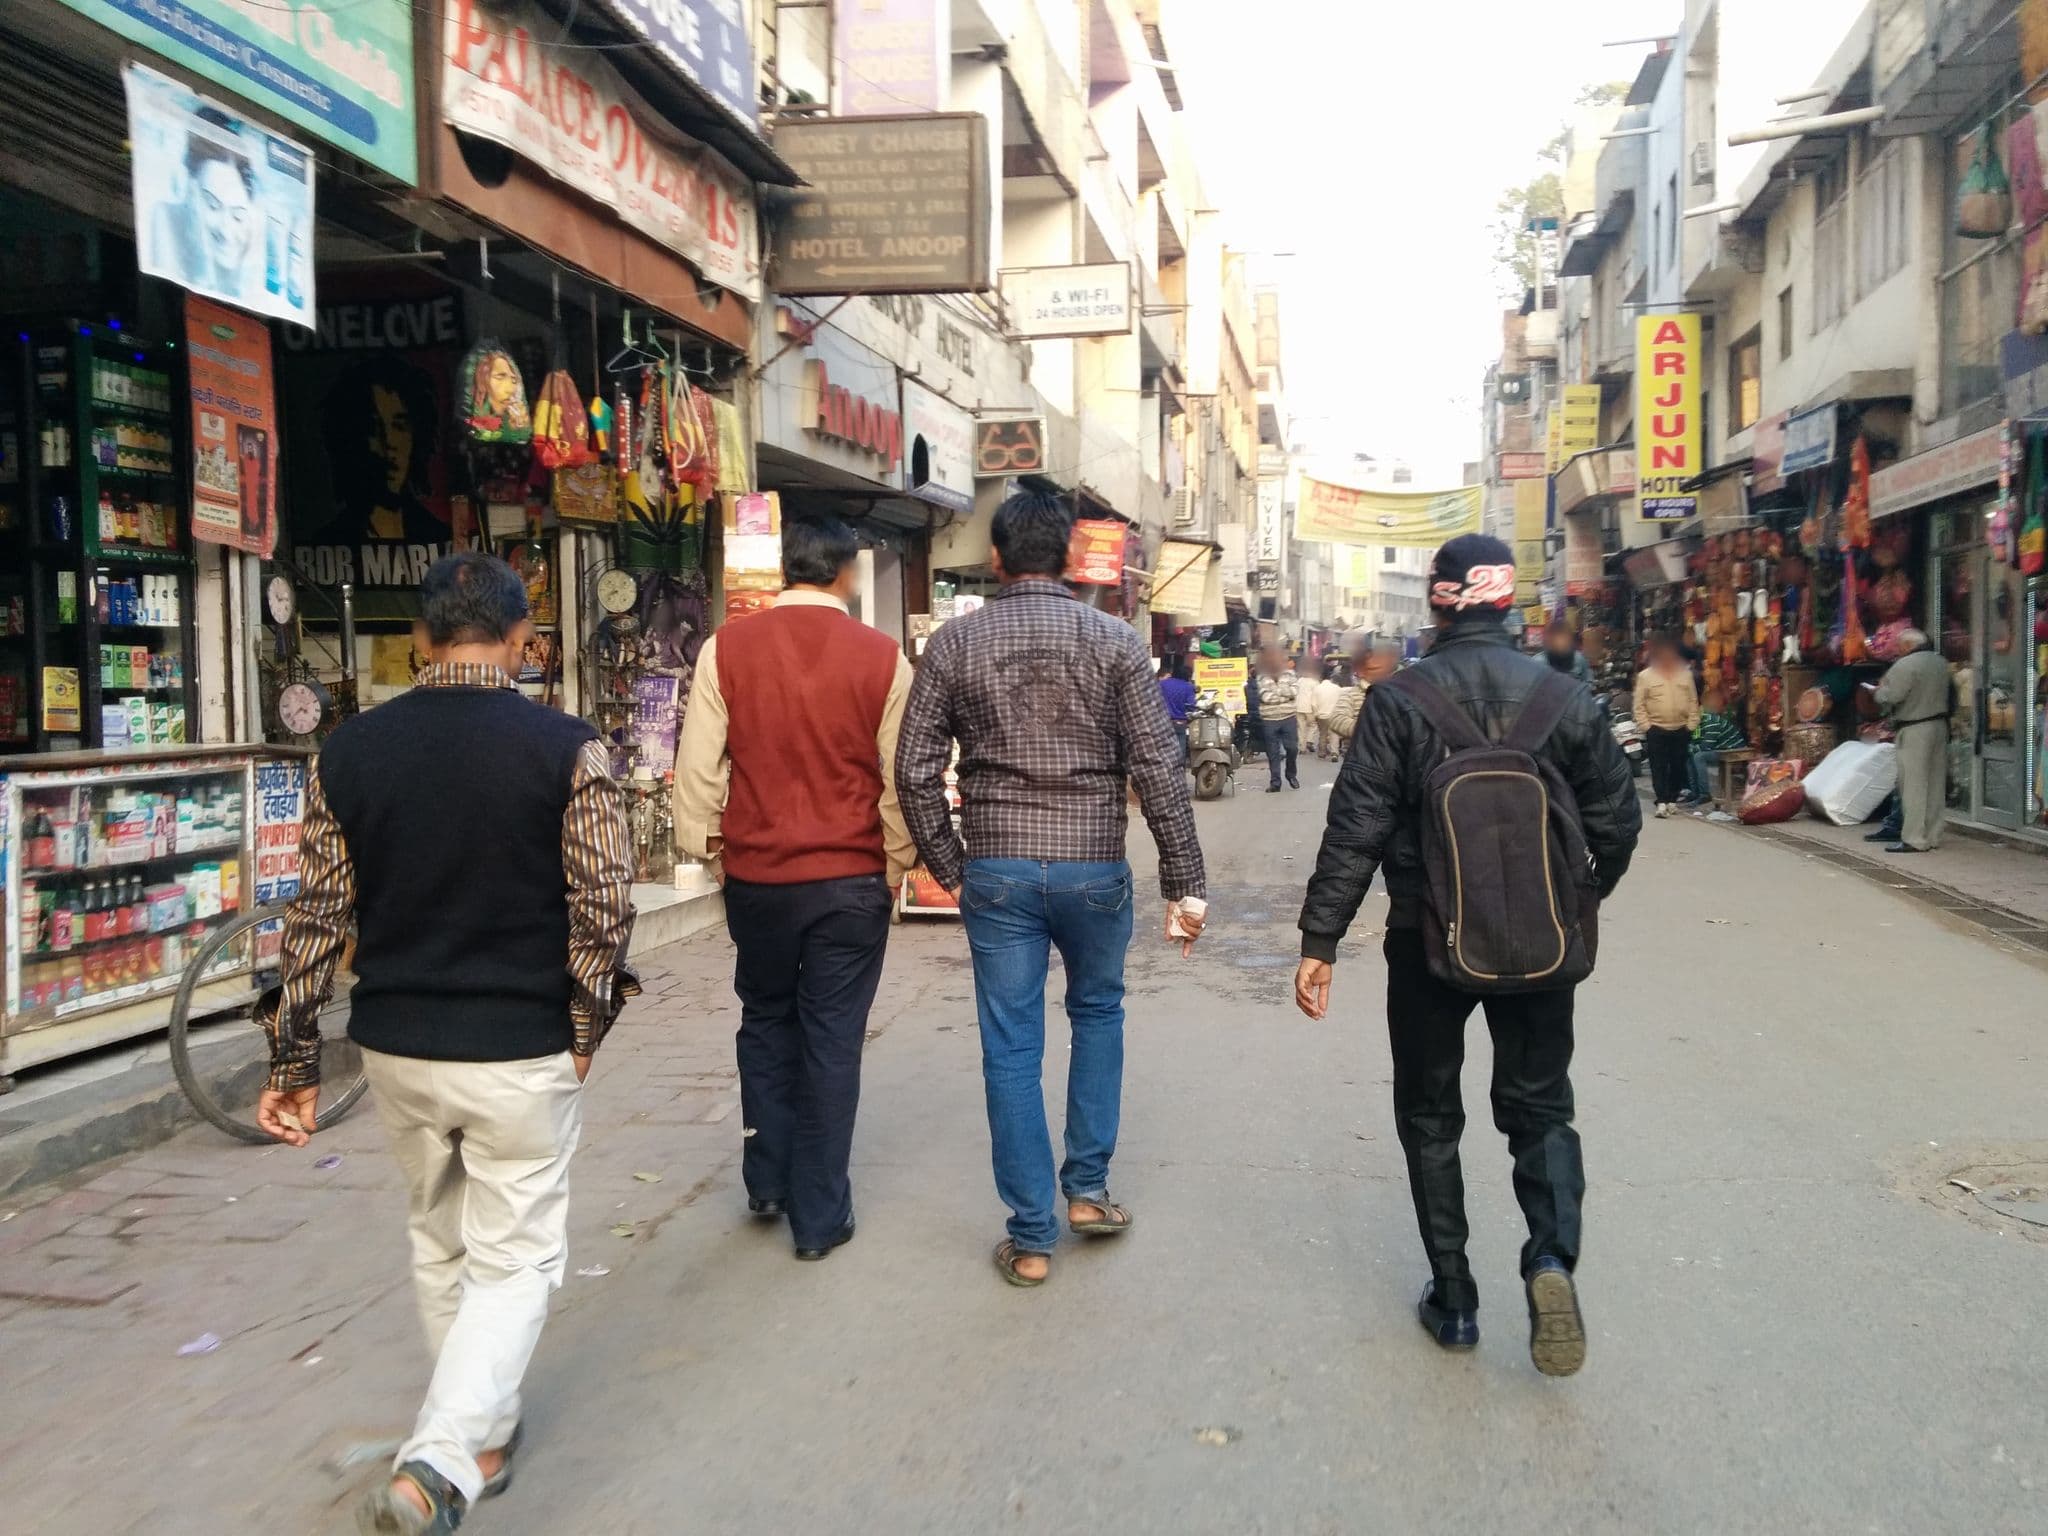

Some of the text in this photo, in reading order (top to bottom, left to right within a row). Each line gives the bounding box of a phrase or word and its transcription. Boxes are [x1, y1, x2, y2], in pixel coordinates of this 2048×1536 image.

[791, 235, 967, 260] HOTEL ANOOP
[1068, 287, 1109, 303] WI-FI
[1094, 303, 1124, 316] OPEN
[1652, 320, 1686, 469] ARJUN
[1641, 477, 1691, 493] HOTE
[1658, 498, 1697, 508] HOURS
[1654, 508, 1686, 518] OPEN
[1263, 504, 1274, 557] VIVEK
